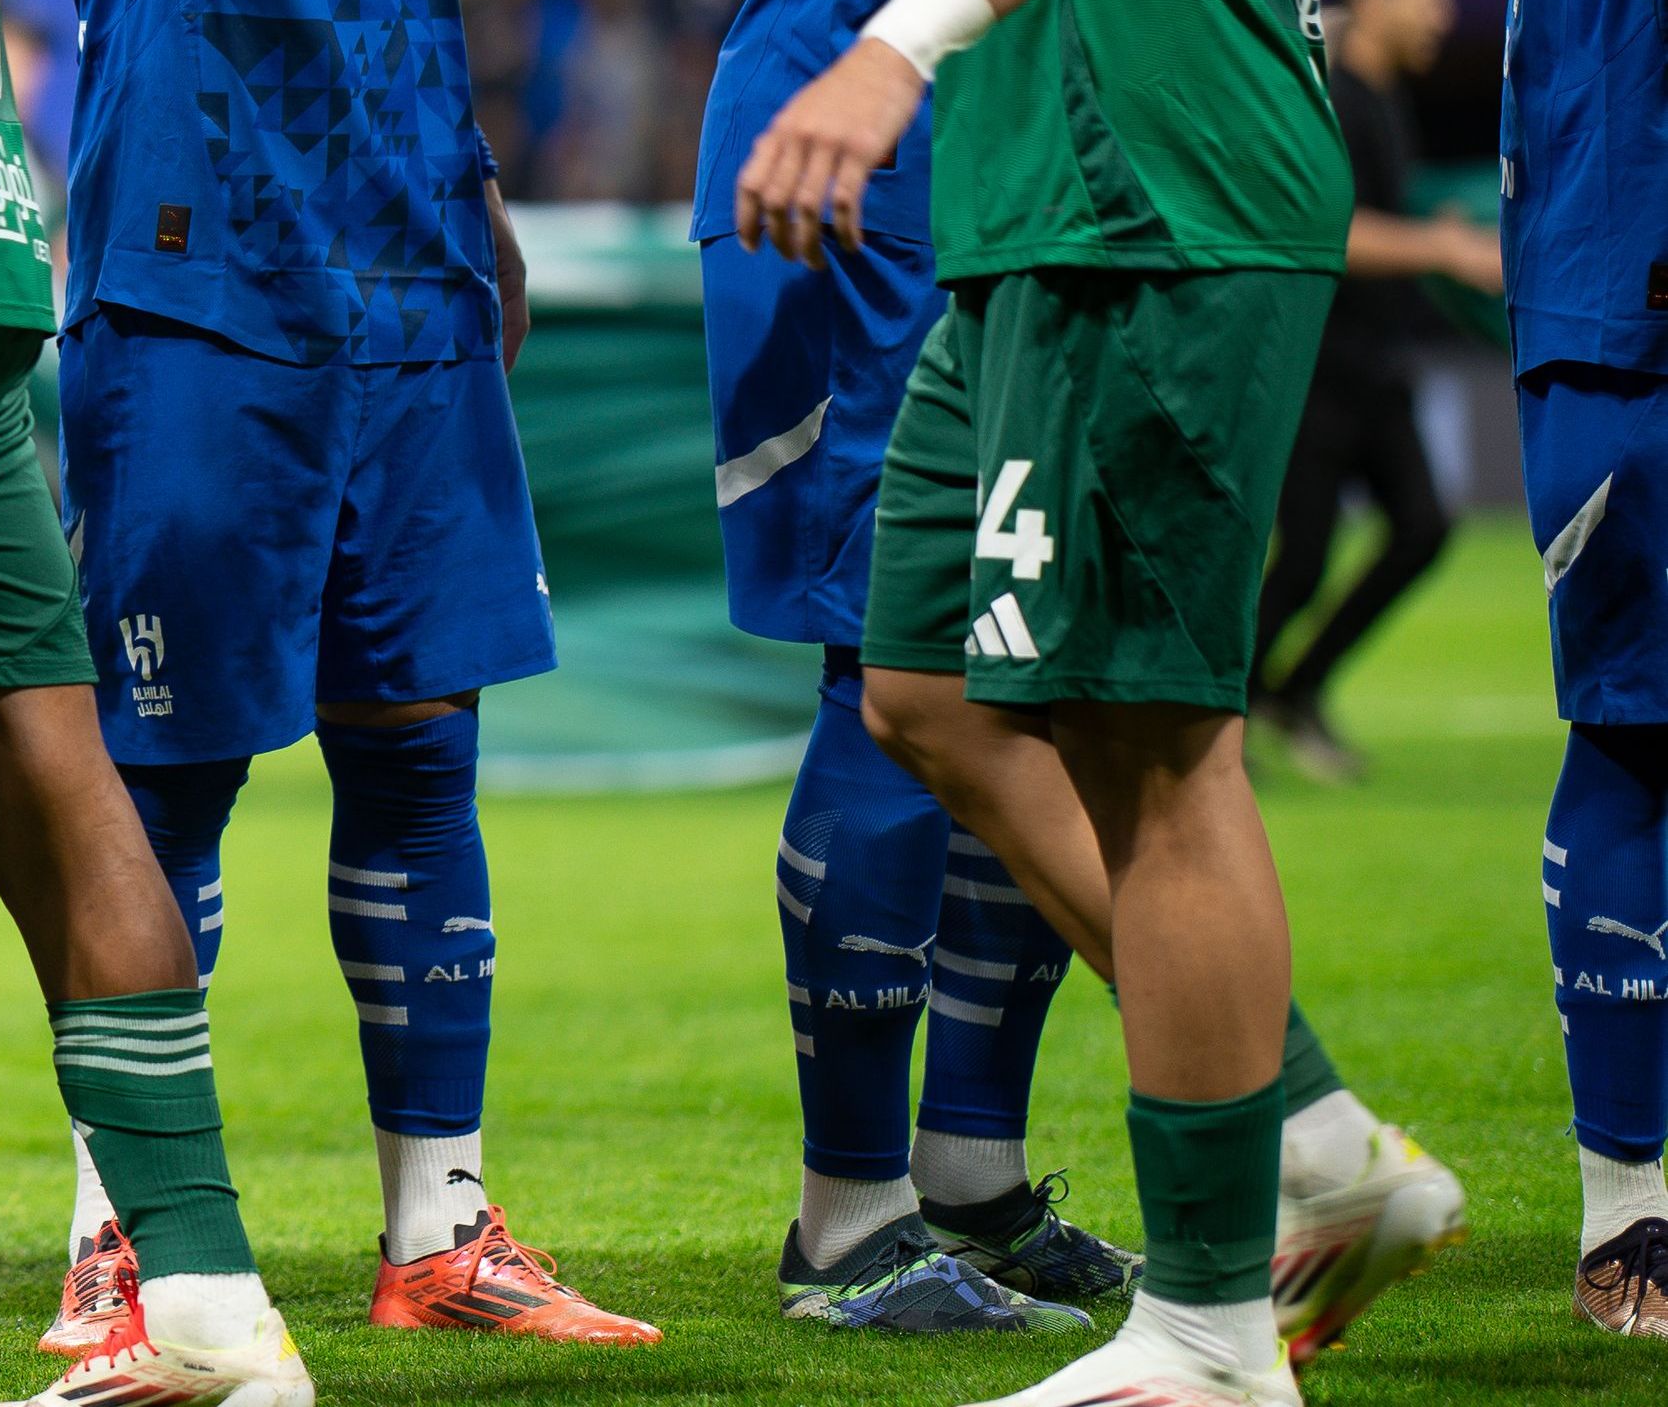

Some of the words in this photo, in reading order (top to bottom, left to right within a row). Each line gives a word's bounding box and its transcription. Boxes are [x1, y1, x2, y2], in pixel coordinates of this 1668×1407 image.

[973, 460, 1054, 580] 4
[132, 685, 174, 702] ALHILAL
[137, 700, 174, 718] الهلال
[424, 964, 469, 983] AL
[1574, 971, 1612, 996] AL
[825, 988, 867, 1010] AL
[876, 979, 933, 1010] HILA
